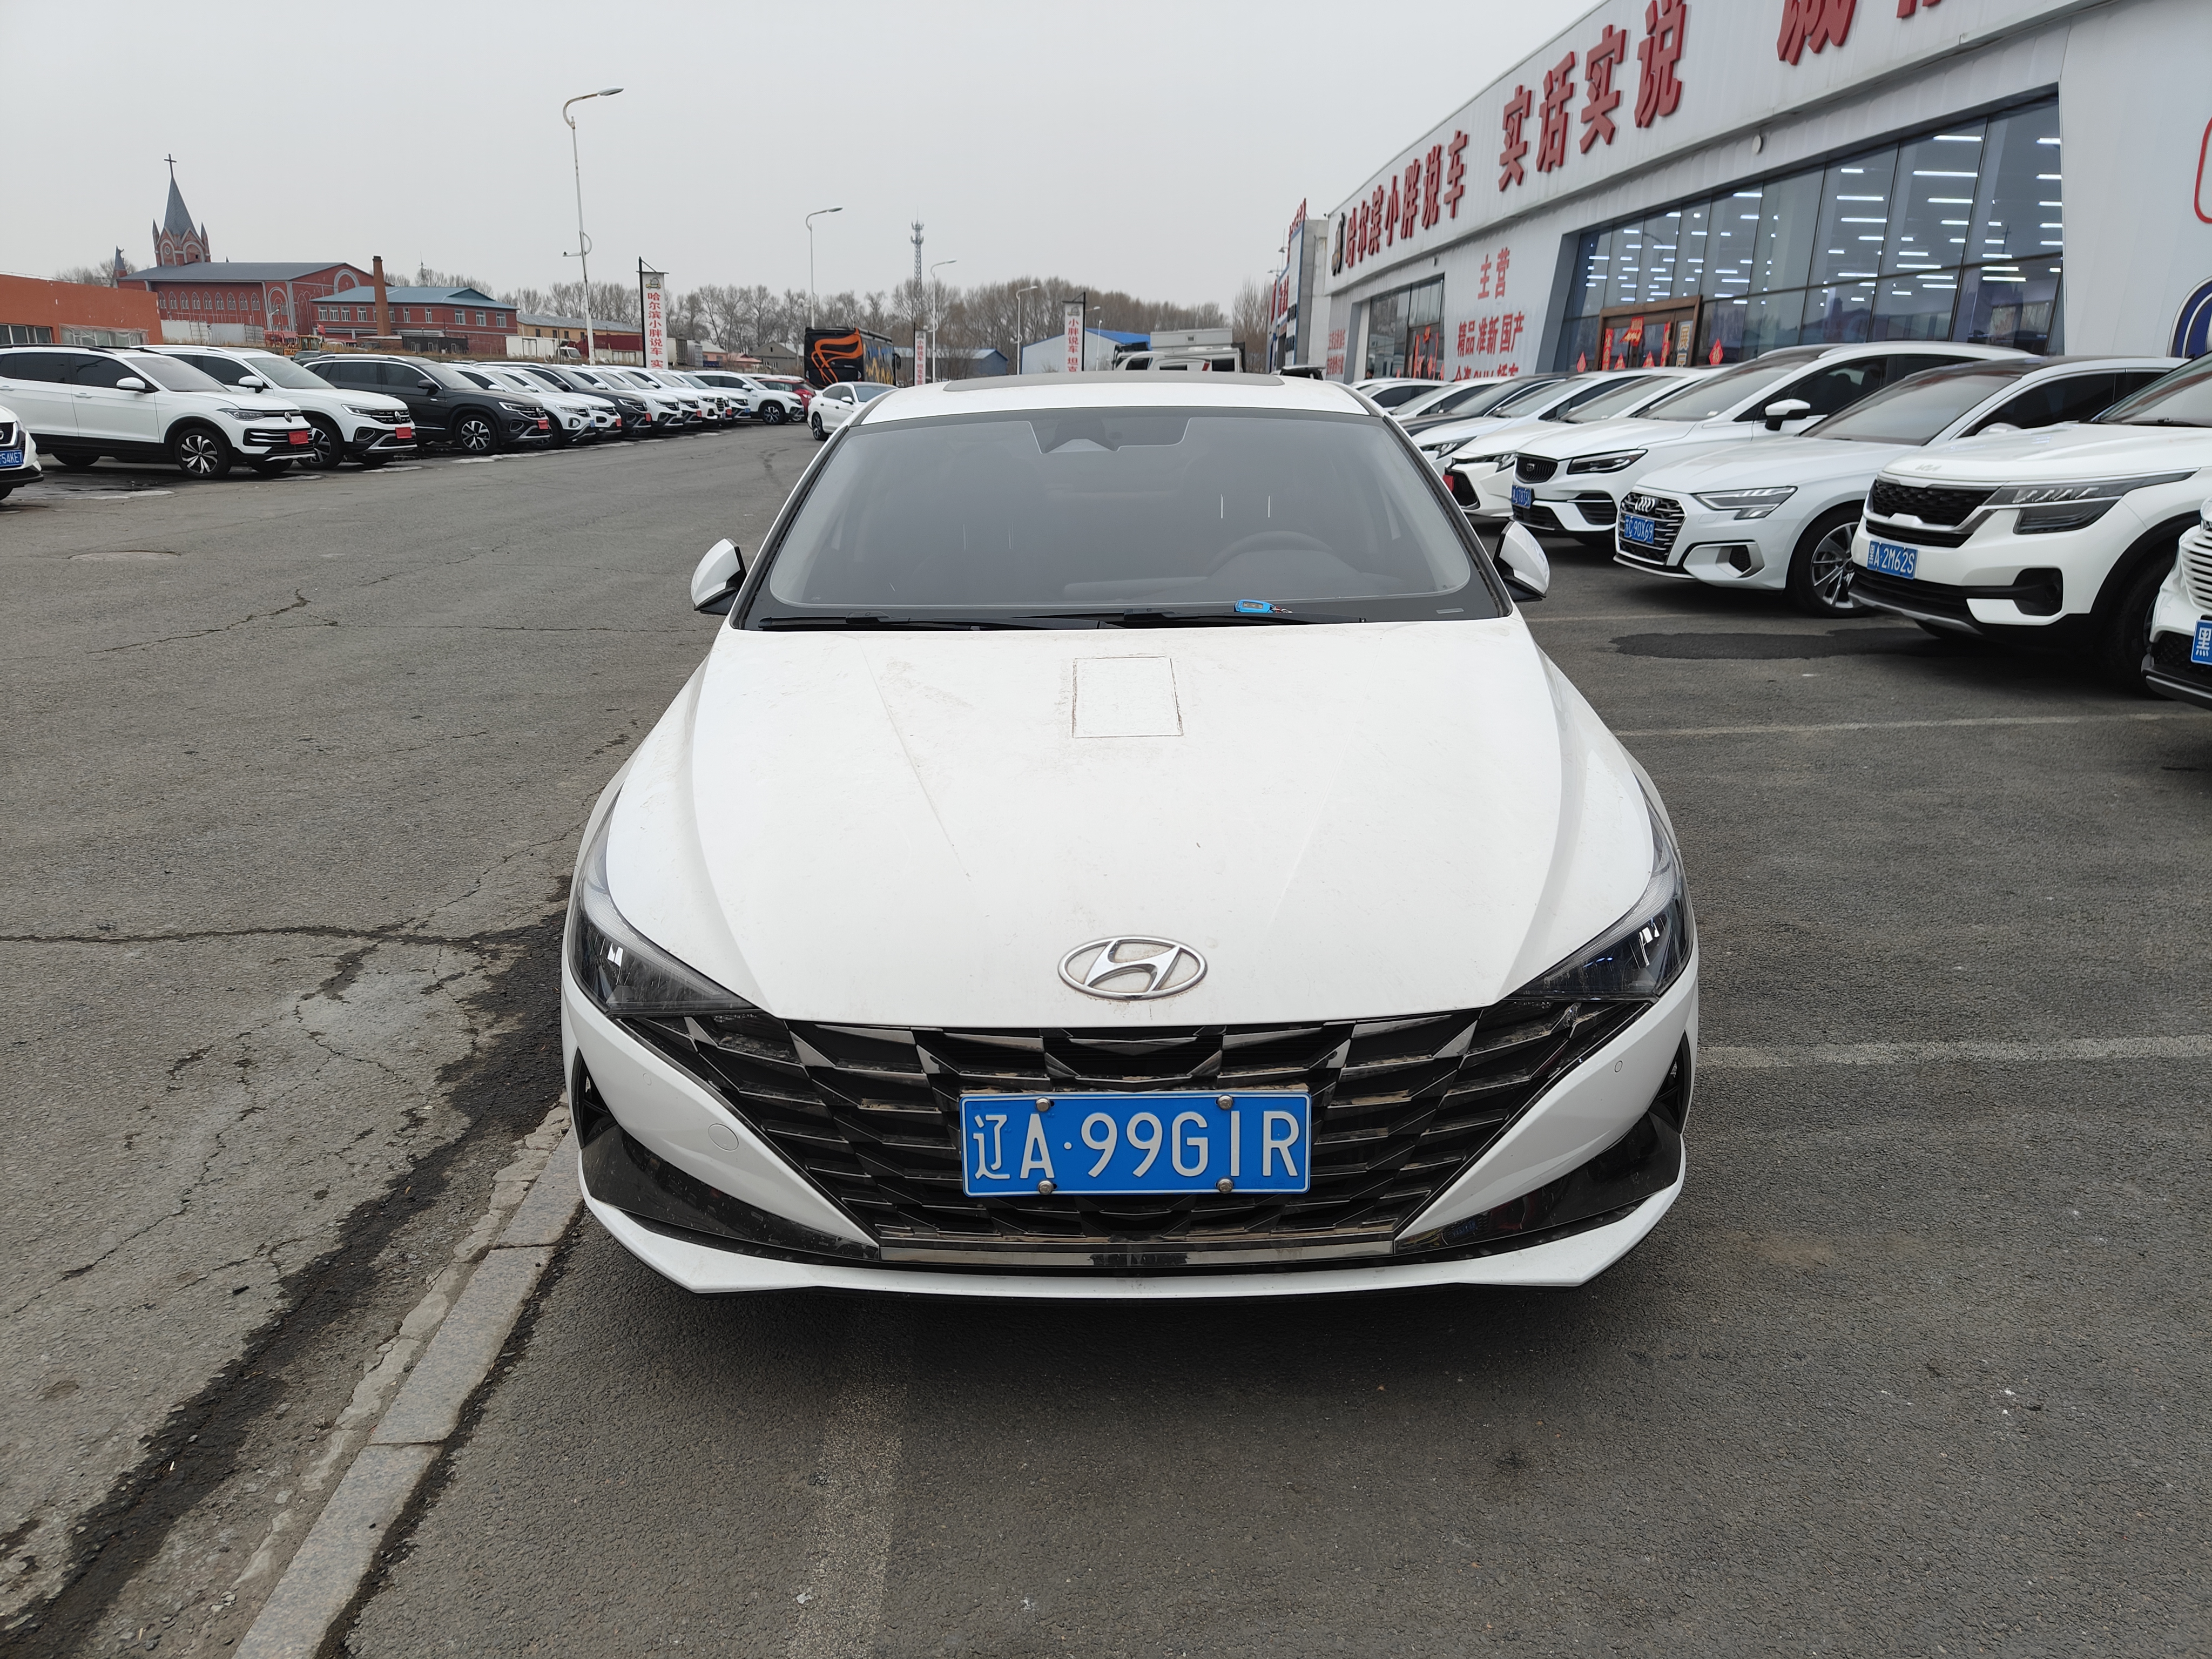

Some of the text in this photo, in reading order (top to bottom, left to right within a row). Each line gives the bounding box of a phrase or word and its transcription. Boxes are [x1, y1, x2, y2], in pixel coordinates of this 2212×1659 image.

[1345, 130, 1468, 268] 哈尔滨小胖说车
[1498, 0, 1687, 192] 实话实说
[1478, 247, 1510, 300] 主营
[648, 292, 663, 355] 哈尔滨小胖说车
[1068, 318, 1079, 353] 小胖说车
[0, 452, 22, 465] 54KE7
